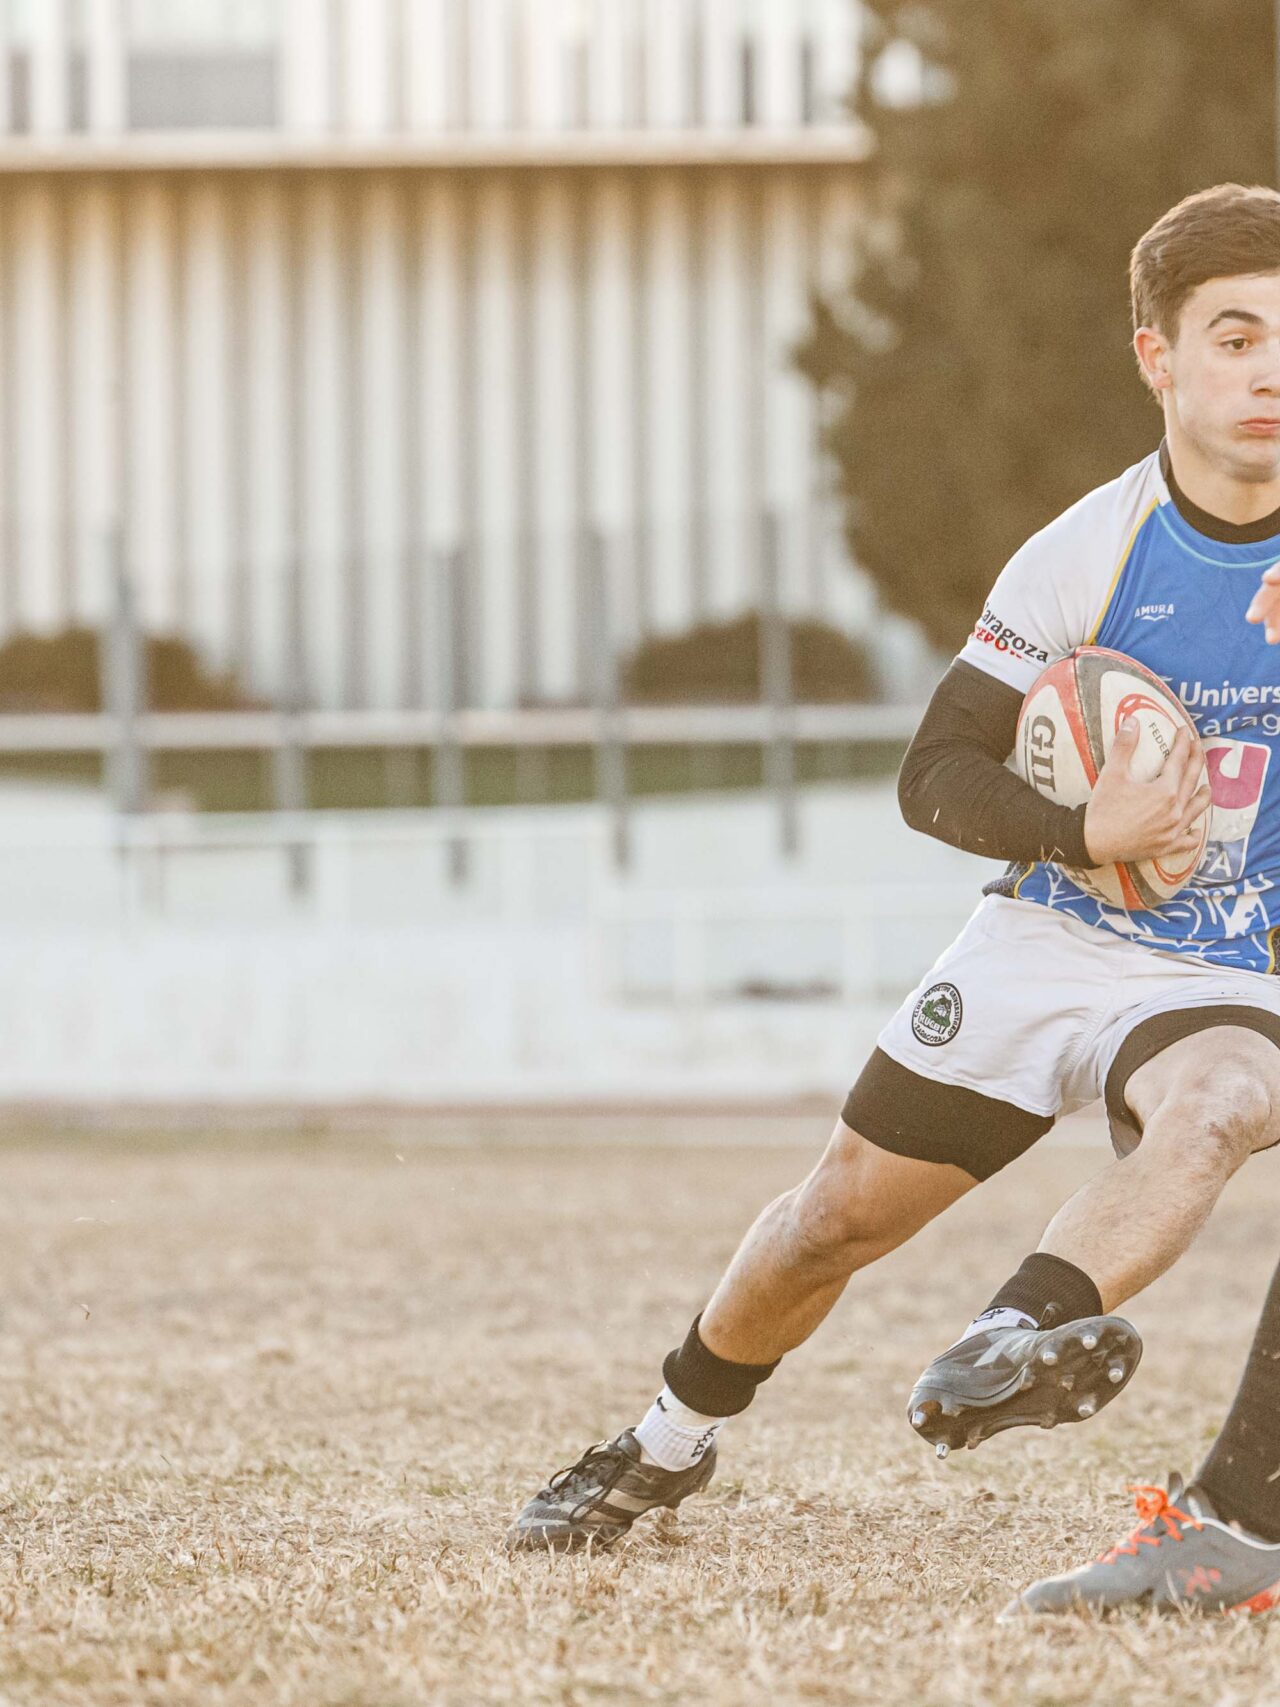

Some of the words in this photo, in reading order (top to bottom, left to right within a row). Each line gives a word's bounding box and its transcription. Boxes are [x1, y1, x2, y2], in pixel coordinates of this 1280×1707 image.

[982, 601, 1049, 664] aragoza
[1134, 603, 1175, 618] AMURA
[1030, 714, 1057, 794] GIL
[1148, 721, 1170, 761] FEDER
